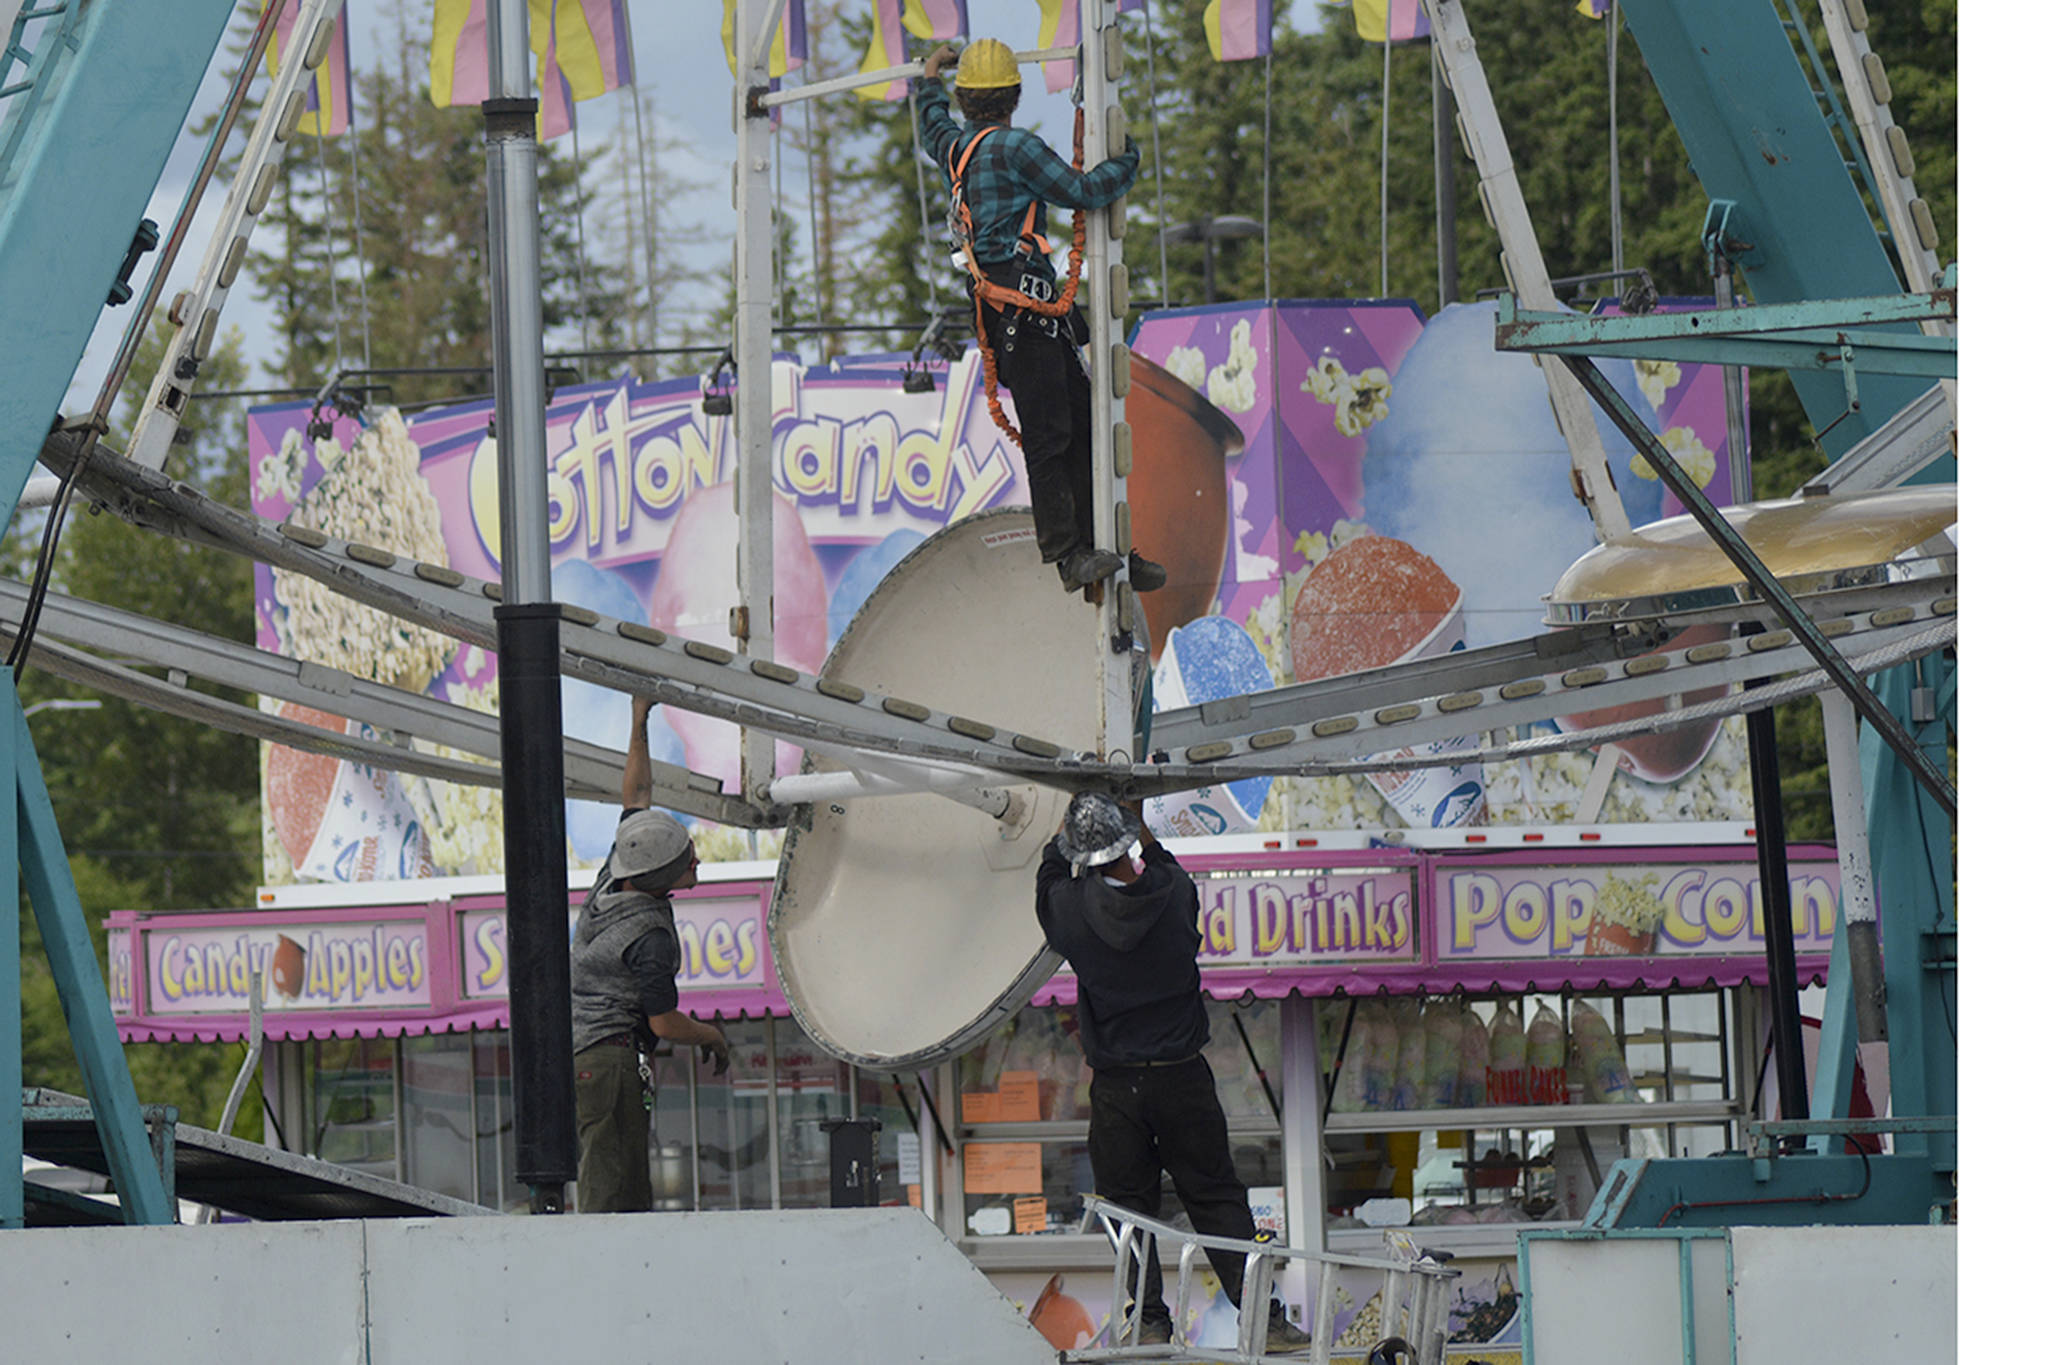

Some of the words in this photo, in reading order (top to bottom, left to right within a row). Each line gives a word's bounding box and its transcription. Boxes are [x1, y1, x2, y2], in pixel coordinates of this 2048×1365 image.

[1250, 877, 1410, 957] Drinks
[1450, 872, 1598, 955] Pop
[160, 935, 272, 1004] Candy
[306, 925, 422, 1003] Apples
